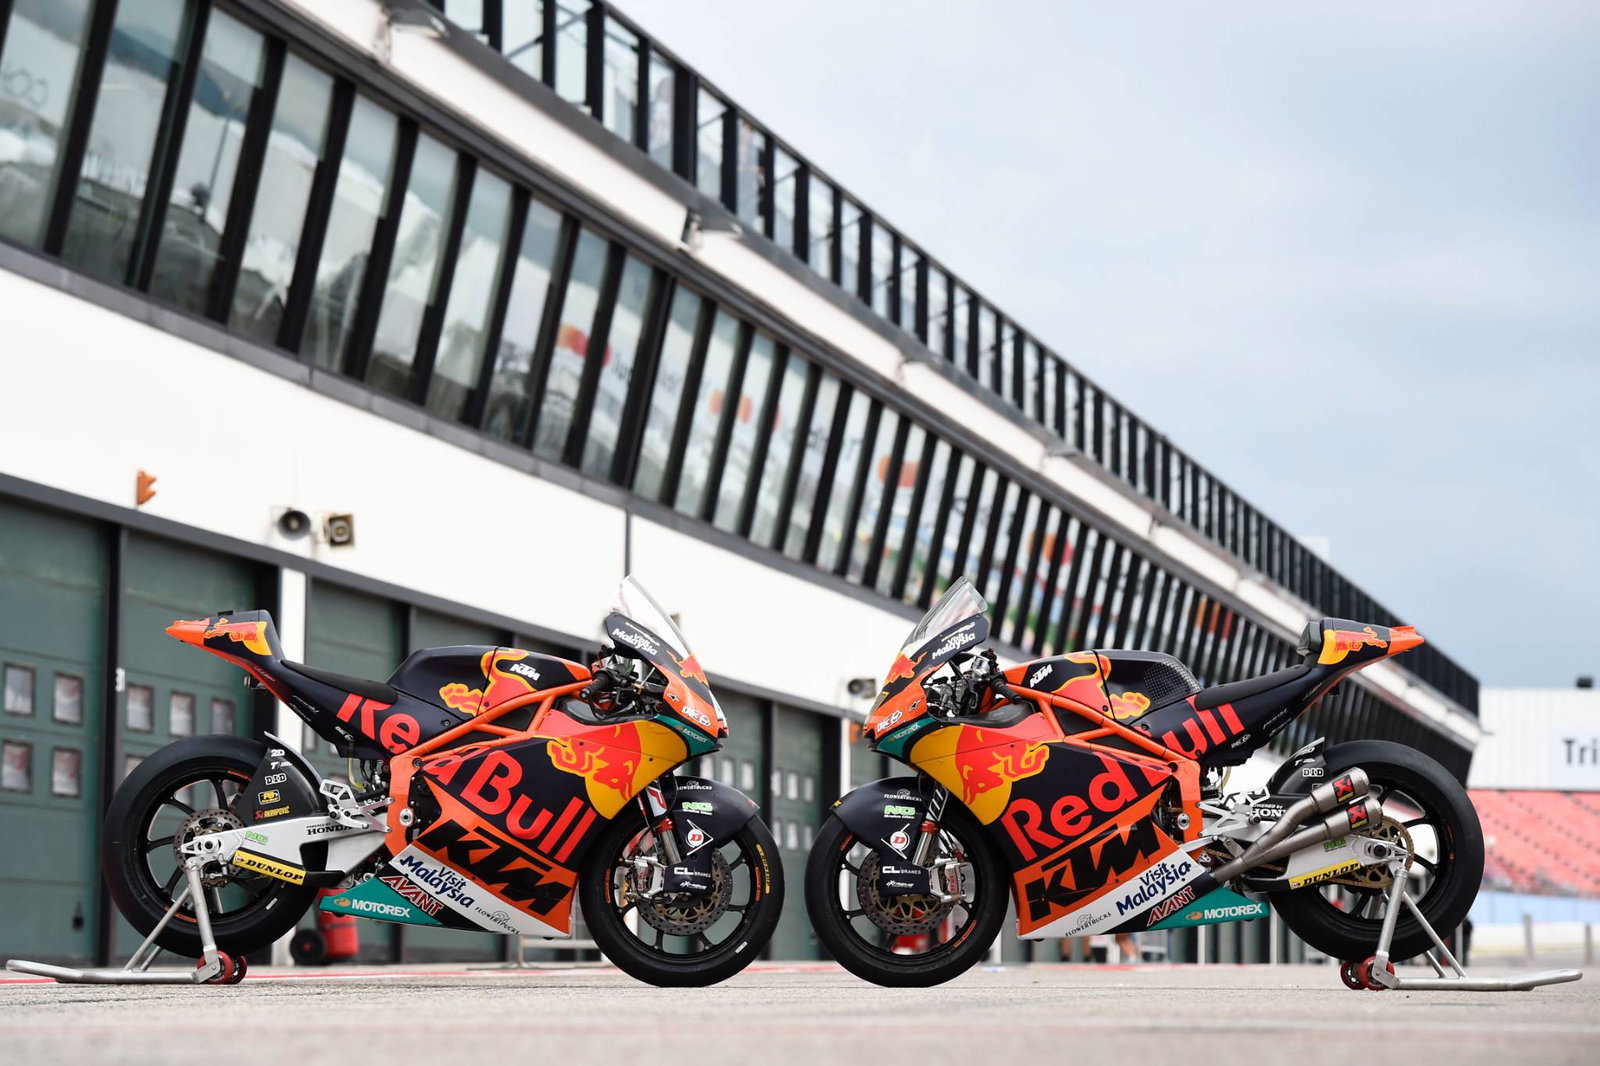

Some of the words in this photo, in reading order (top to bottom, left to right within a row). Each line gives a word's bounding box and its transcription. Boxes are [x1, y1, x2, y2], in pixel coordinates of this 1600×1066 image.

[612, 628, 658, 656] Malaysia
[932, 632, 976, 660] Malaysia
[509, 662, 541, 681] KTM
[1029, 663, 1053, 688] KTM
[893, 722, 921, 739] MOTOREX
[1563, 738, 1599, 765] Tri
[460, 750, 597, 864] Bull
[1001, 753, 1138, 861] Red
[307, 823, 353, 836] HONDA
[246, 859, 304, 881] DUNLOP
[418, 819, 571, 916] KTM
[438, 866, 467, 891] Visit
[673, 866, 695, 875] CL
[882, 866, 900, 874] CL
[1025, 814, 1162, 923] KTM
[1139, 862, 1170, 887] Visit
[1303, 862, 1359, 886] DUNLOP
[400, 854, 475, 909] Malaysia
[1115, 860, 1192, 916] Malaysia
[351, 898, 412, 918] MOTOREX
[381, 875, 444, 916] AVANT
[1146, 886, 1196, 927] AVANT
[474, 905, 521, 936] FLOWERTRUCKS
[1064, 911, 1112, 938] FLOWERTRUCKS
[1203, 903, 1263, 920] MOTOREX
